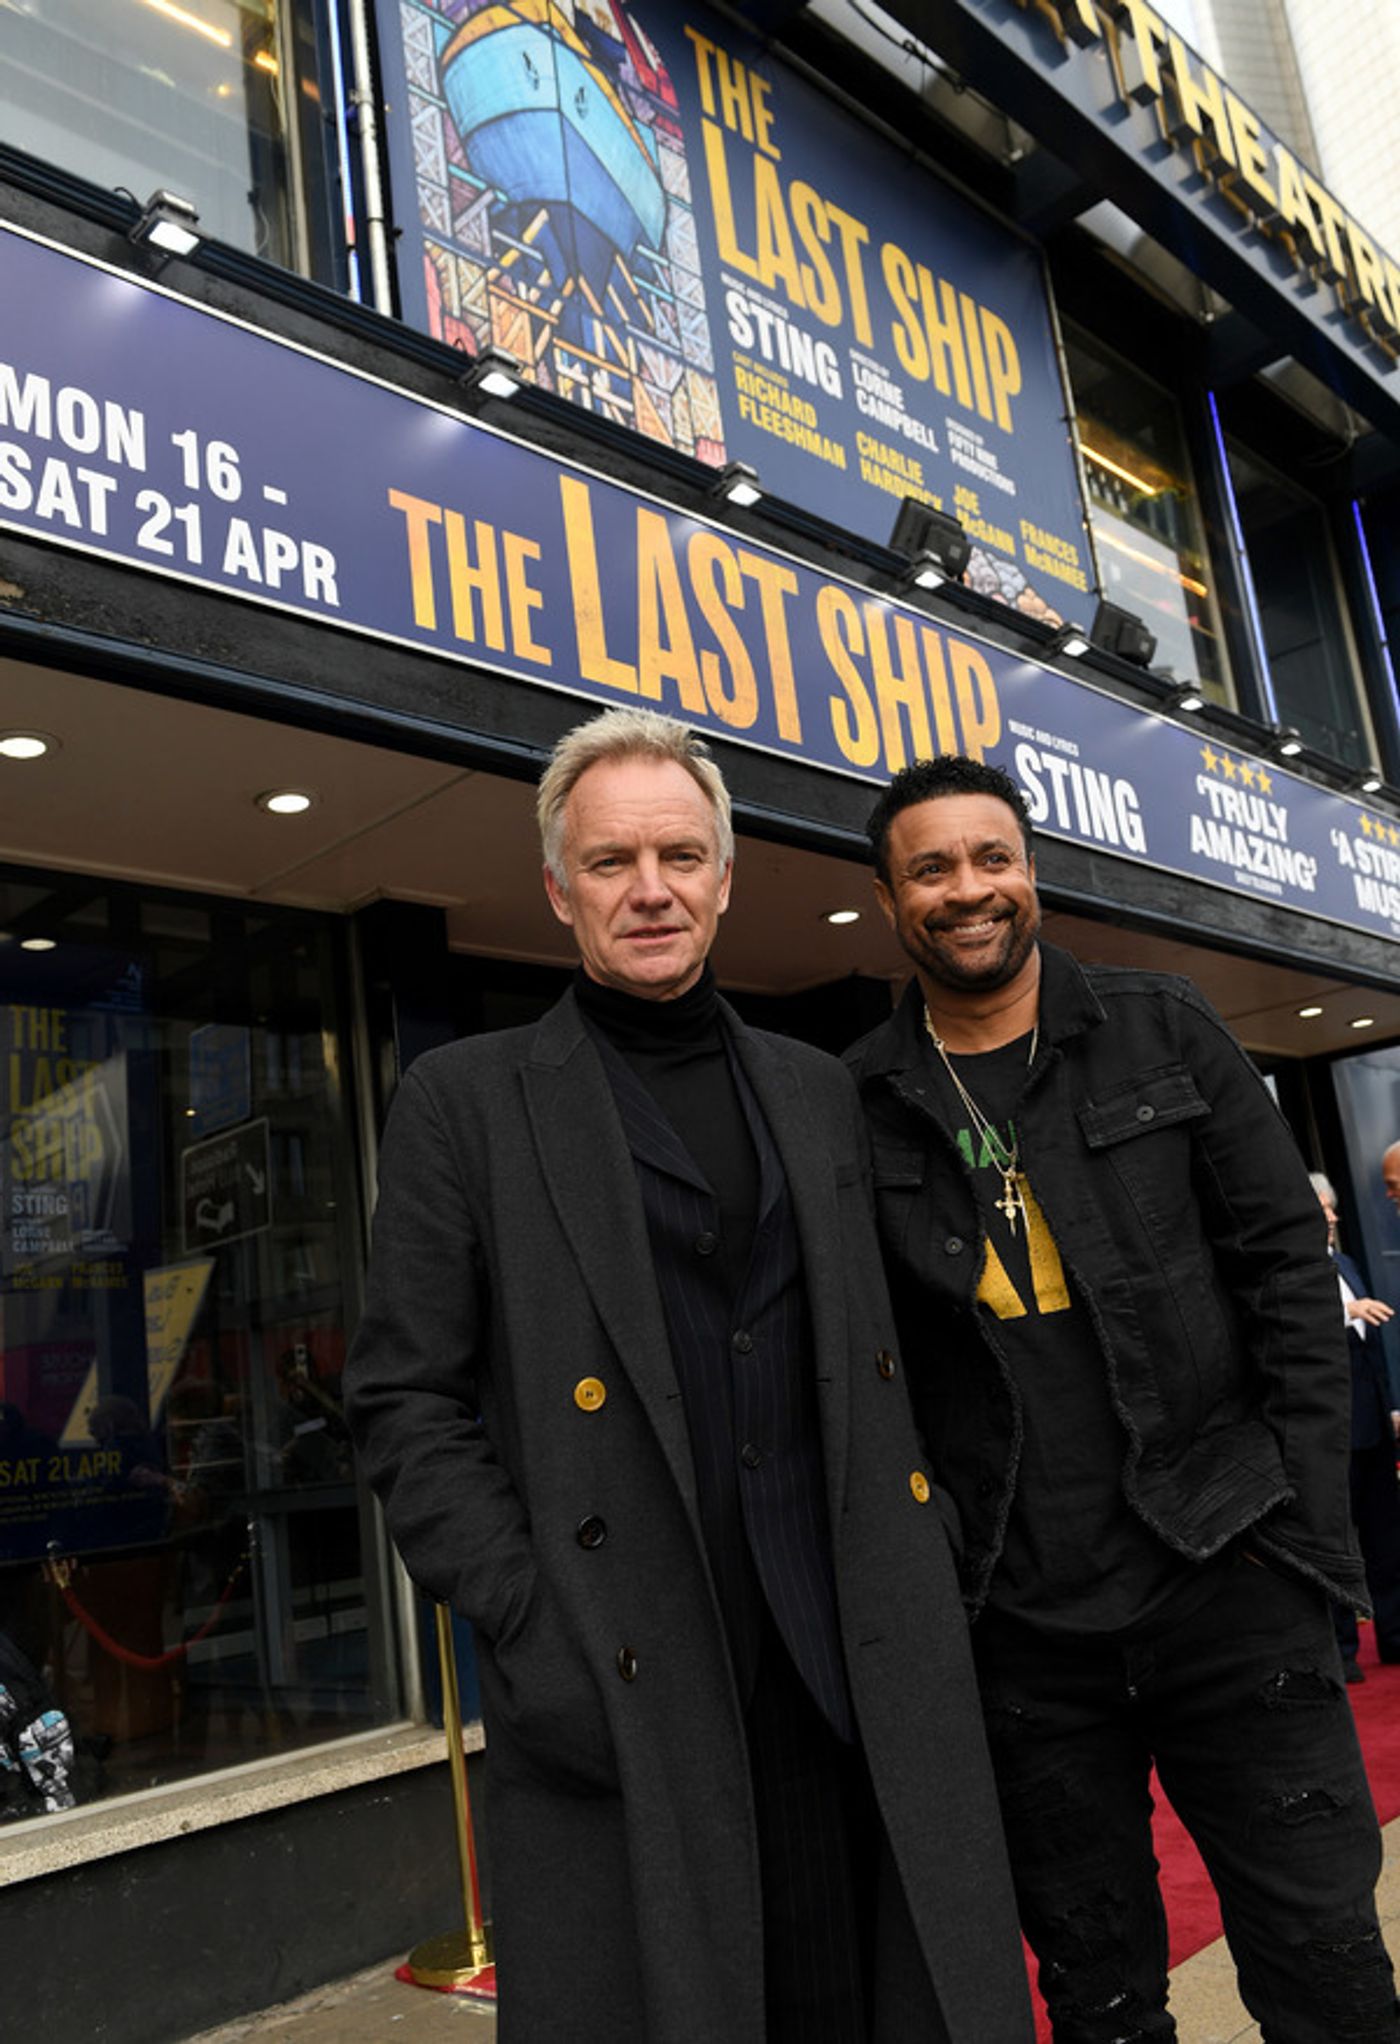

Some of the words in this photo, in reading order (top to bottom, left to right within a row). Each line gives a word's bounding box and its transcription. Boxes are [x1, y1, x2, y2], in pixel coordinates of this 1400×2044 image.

[684, 25, 782, 161] THE
[702, 117, 874, 349] LAST
[881, 242, 1022, 434] SHIP
[725, 290, 843, 399] STING
[0, 362, 147, 472] MON
[172, 429, 242, 502] 16
[734, 365, 818, 430] RICHARD
[737, 393, 848, 471] FLEESHMAN
[856, 388, 939, 453] CAMPBELL
[856, 431, 924, 486] CHARLIE
[0, 441, 118, 536] SAT
[136, 490, 203, 565] 21
[223, 517, 340, 607] APR
[388, 487, 552, 666] THE
[559, 474, 803, 746] LAST
[816, 585, 1002, 776] SHIP
[1014, 742, 1148, 854] STING
[10, 1004, 68, 1051] THE
[9, 1053, 101, 1119] LAST
[11, 1119, 104, 1182] SHIP
[11, 1193, 69, 1215] STING
[0, 1456, 41, 1488] SAT
[77, 1449, 121, 1480] APR
